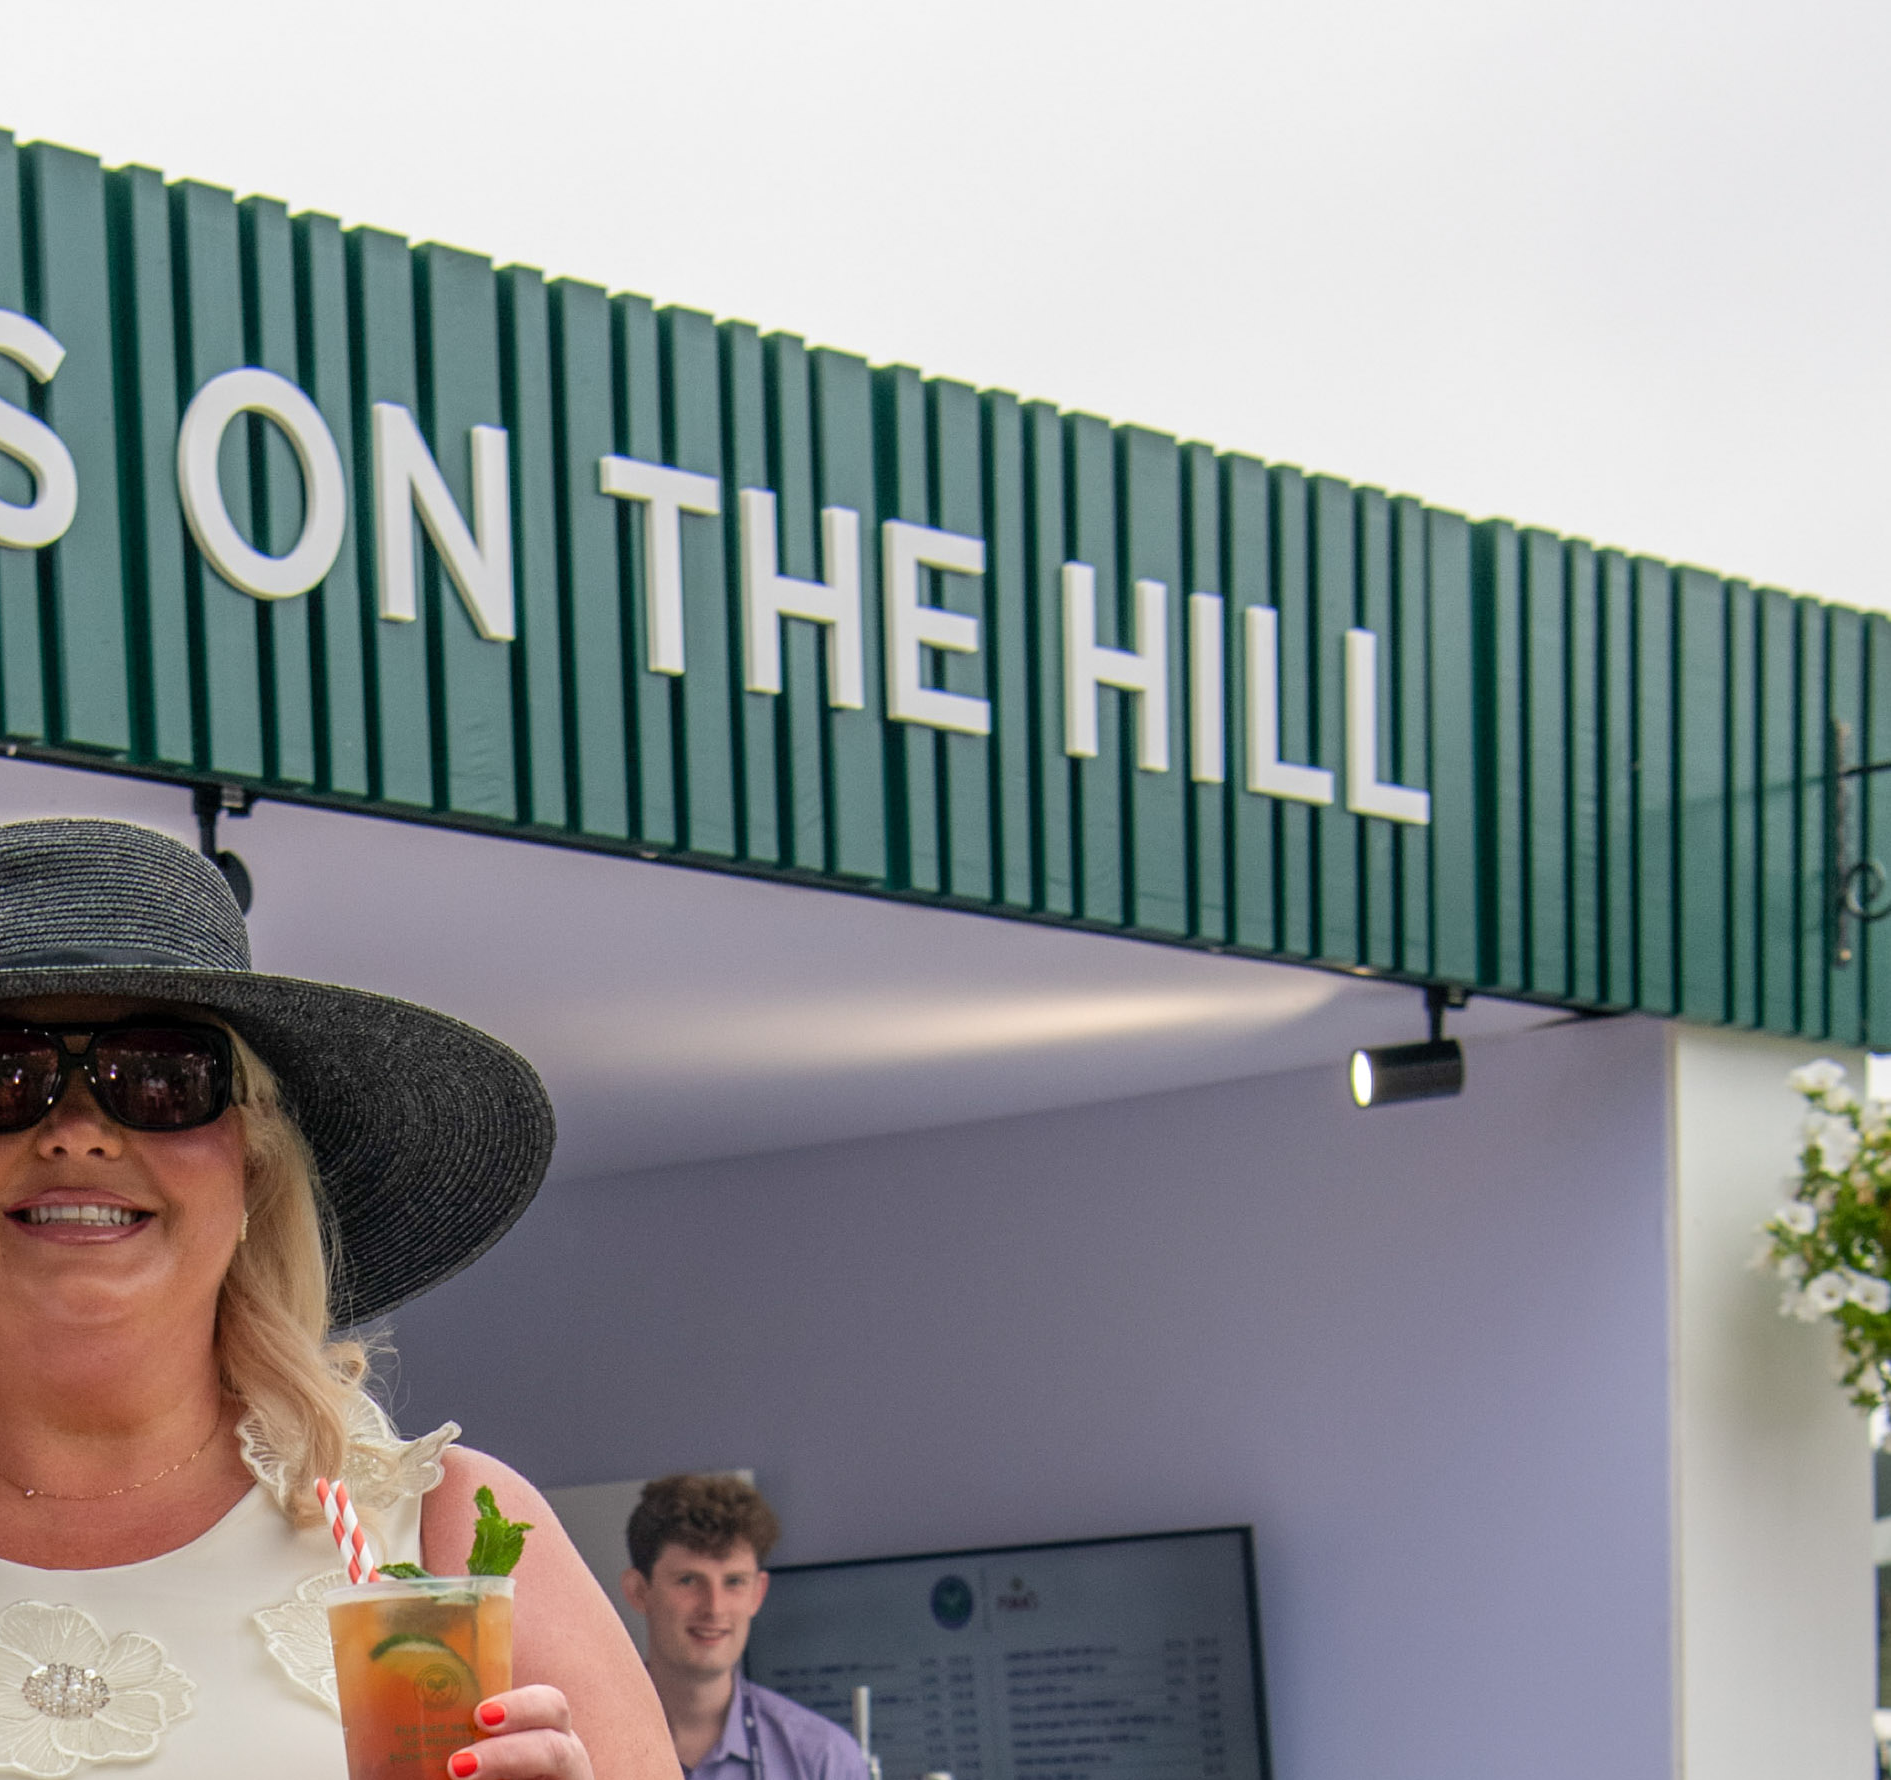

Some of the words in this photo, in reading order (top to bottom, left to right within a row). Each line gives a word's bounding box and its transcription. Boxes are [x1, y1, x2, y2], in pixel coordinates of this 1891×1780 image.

[177, 367, 516, 642] ON
[597, 453, 991, 738] THE
[1059, 560, 1431, 827] HILL
